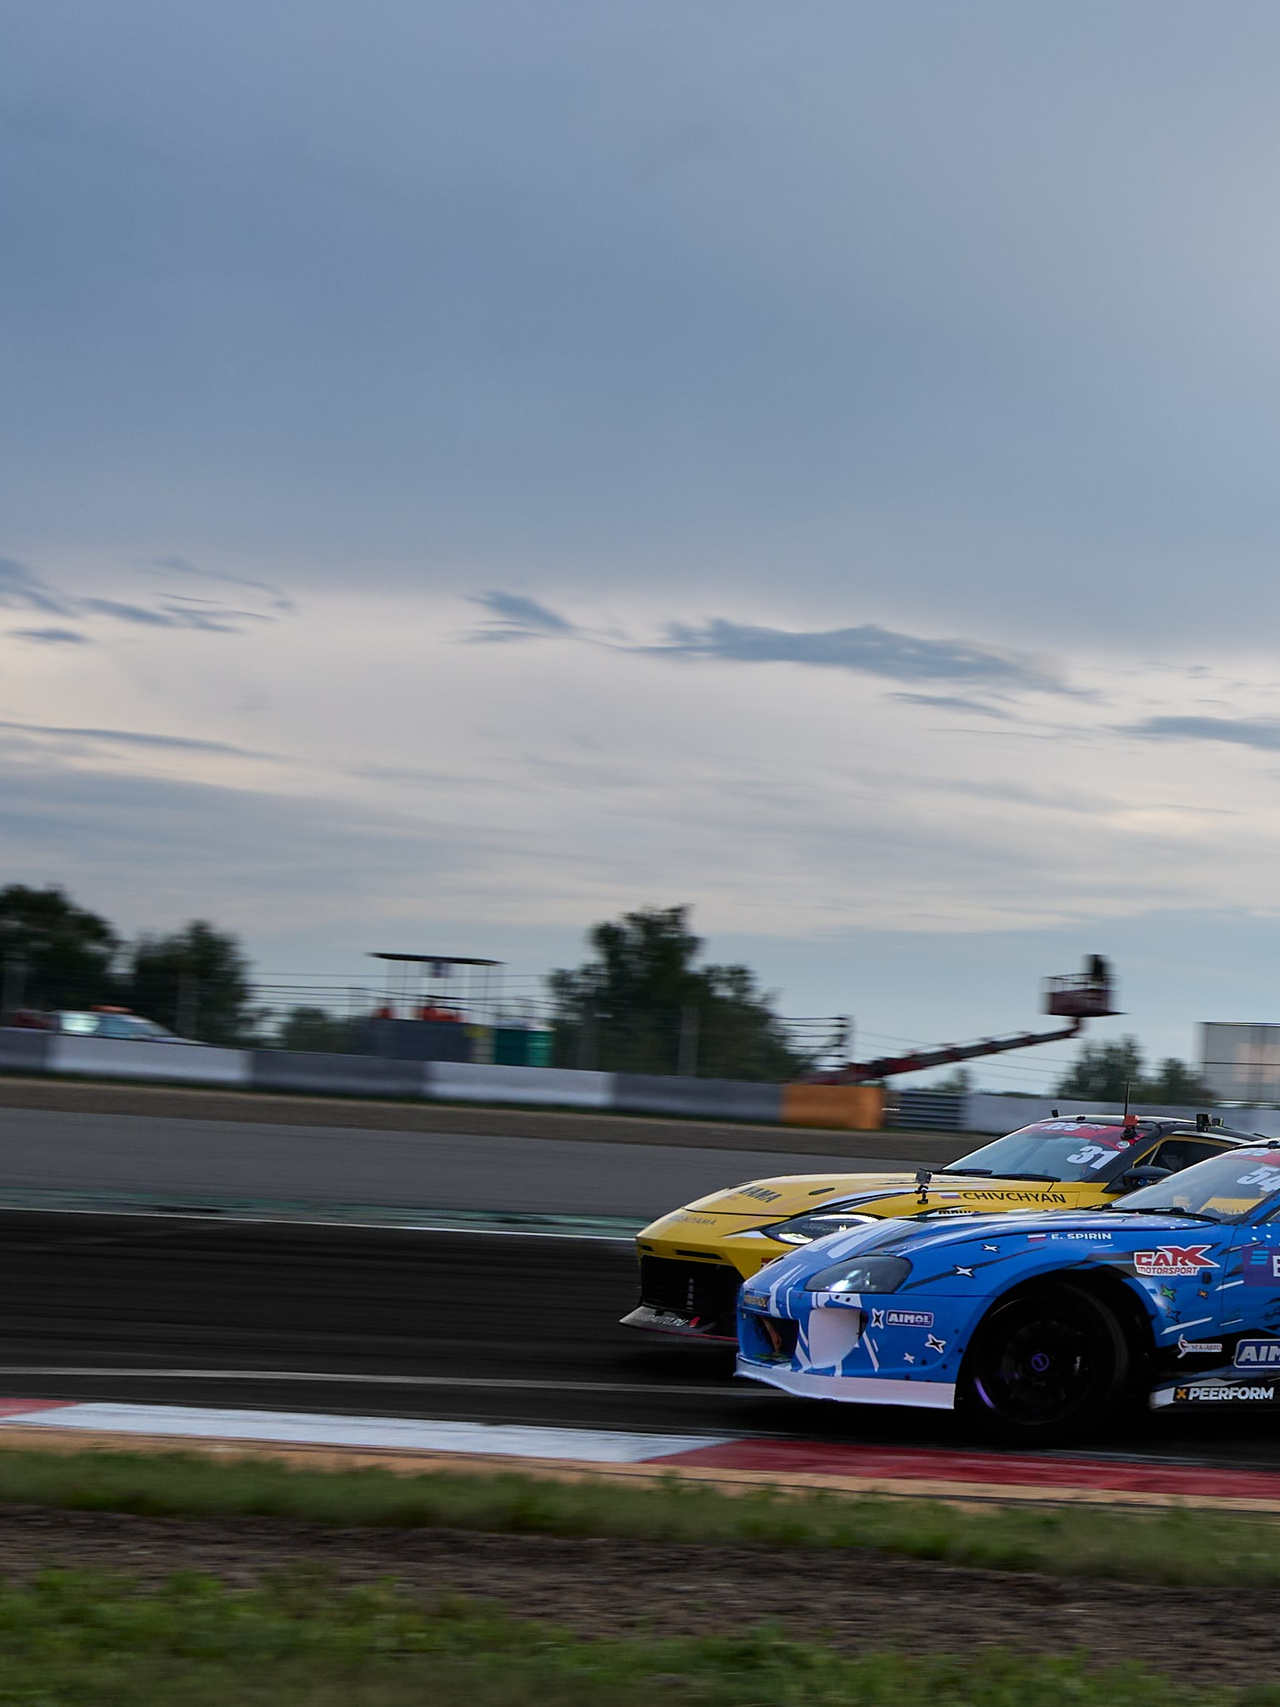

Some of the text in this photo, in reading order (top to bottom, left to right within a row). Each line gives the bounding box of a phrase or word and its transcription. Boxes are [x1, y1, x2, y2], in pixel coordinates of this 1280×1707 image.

[1066, 1145, 1121, 1170] 31
[962, 1192, 1067, 1204] CHIVCHYAN
[1137, 1266, 1198, 1275] MOTORSPORT
[888, 1313, 931, 1324] AIMOL
[1188, 1386, 1275, 1400] PEERFORM
